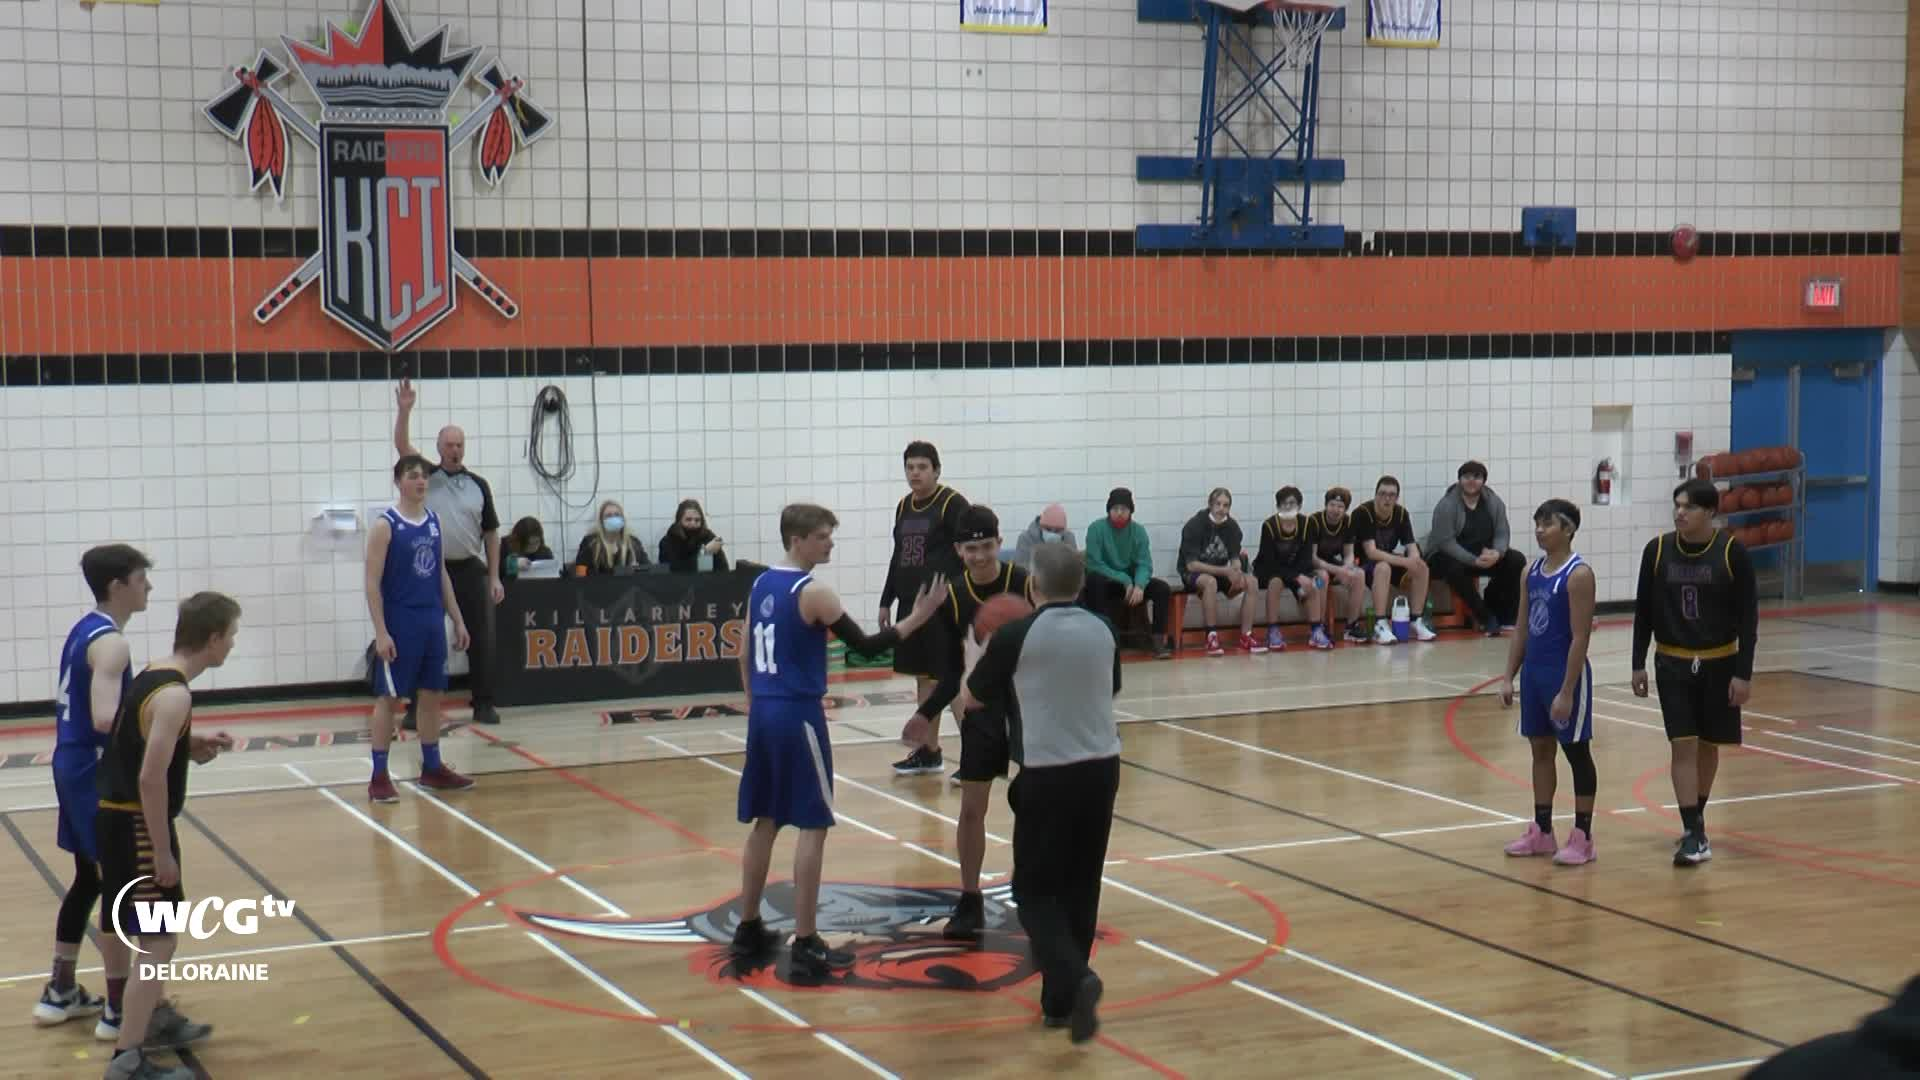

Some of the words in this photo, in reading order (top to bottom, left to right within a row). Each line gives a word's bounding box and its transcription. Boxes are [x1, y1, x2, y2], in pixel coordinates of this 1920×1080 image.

[334, 176, 442, 331] KCI
[524, 601, 746, 627] KILLARNEY
[524, 619, 746, 669] RAIDERS
[753, 621, 778, 674] 11
